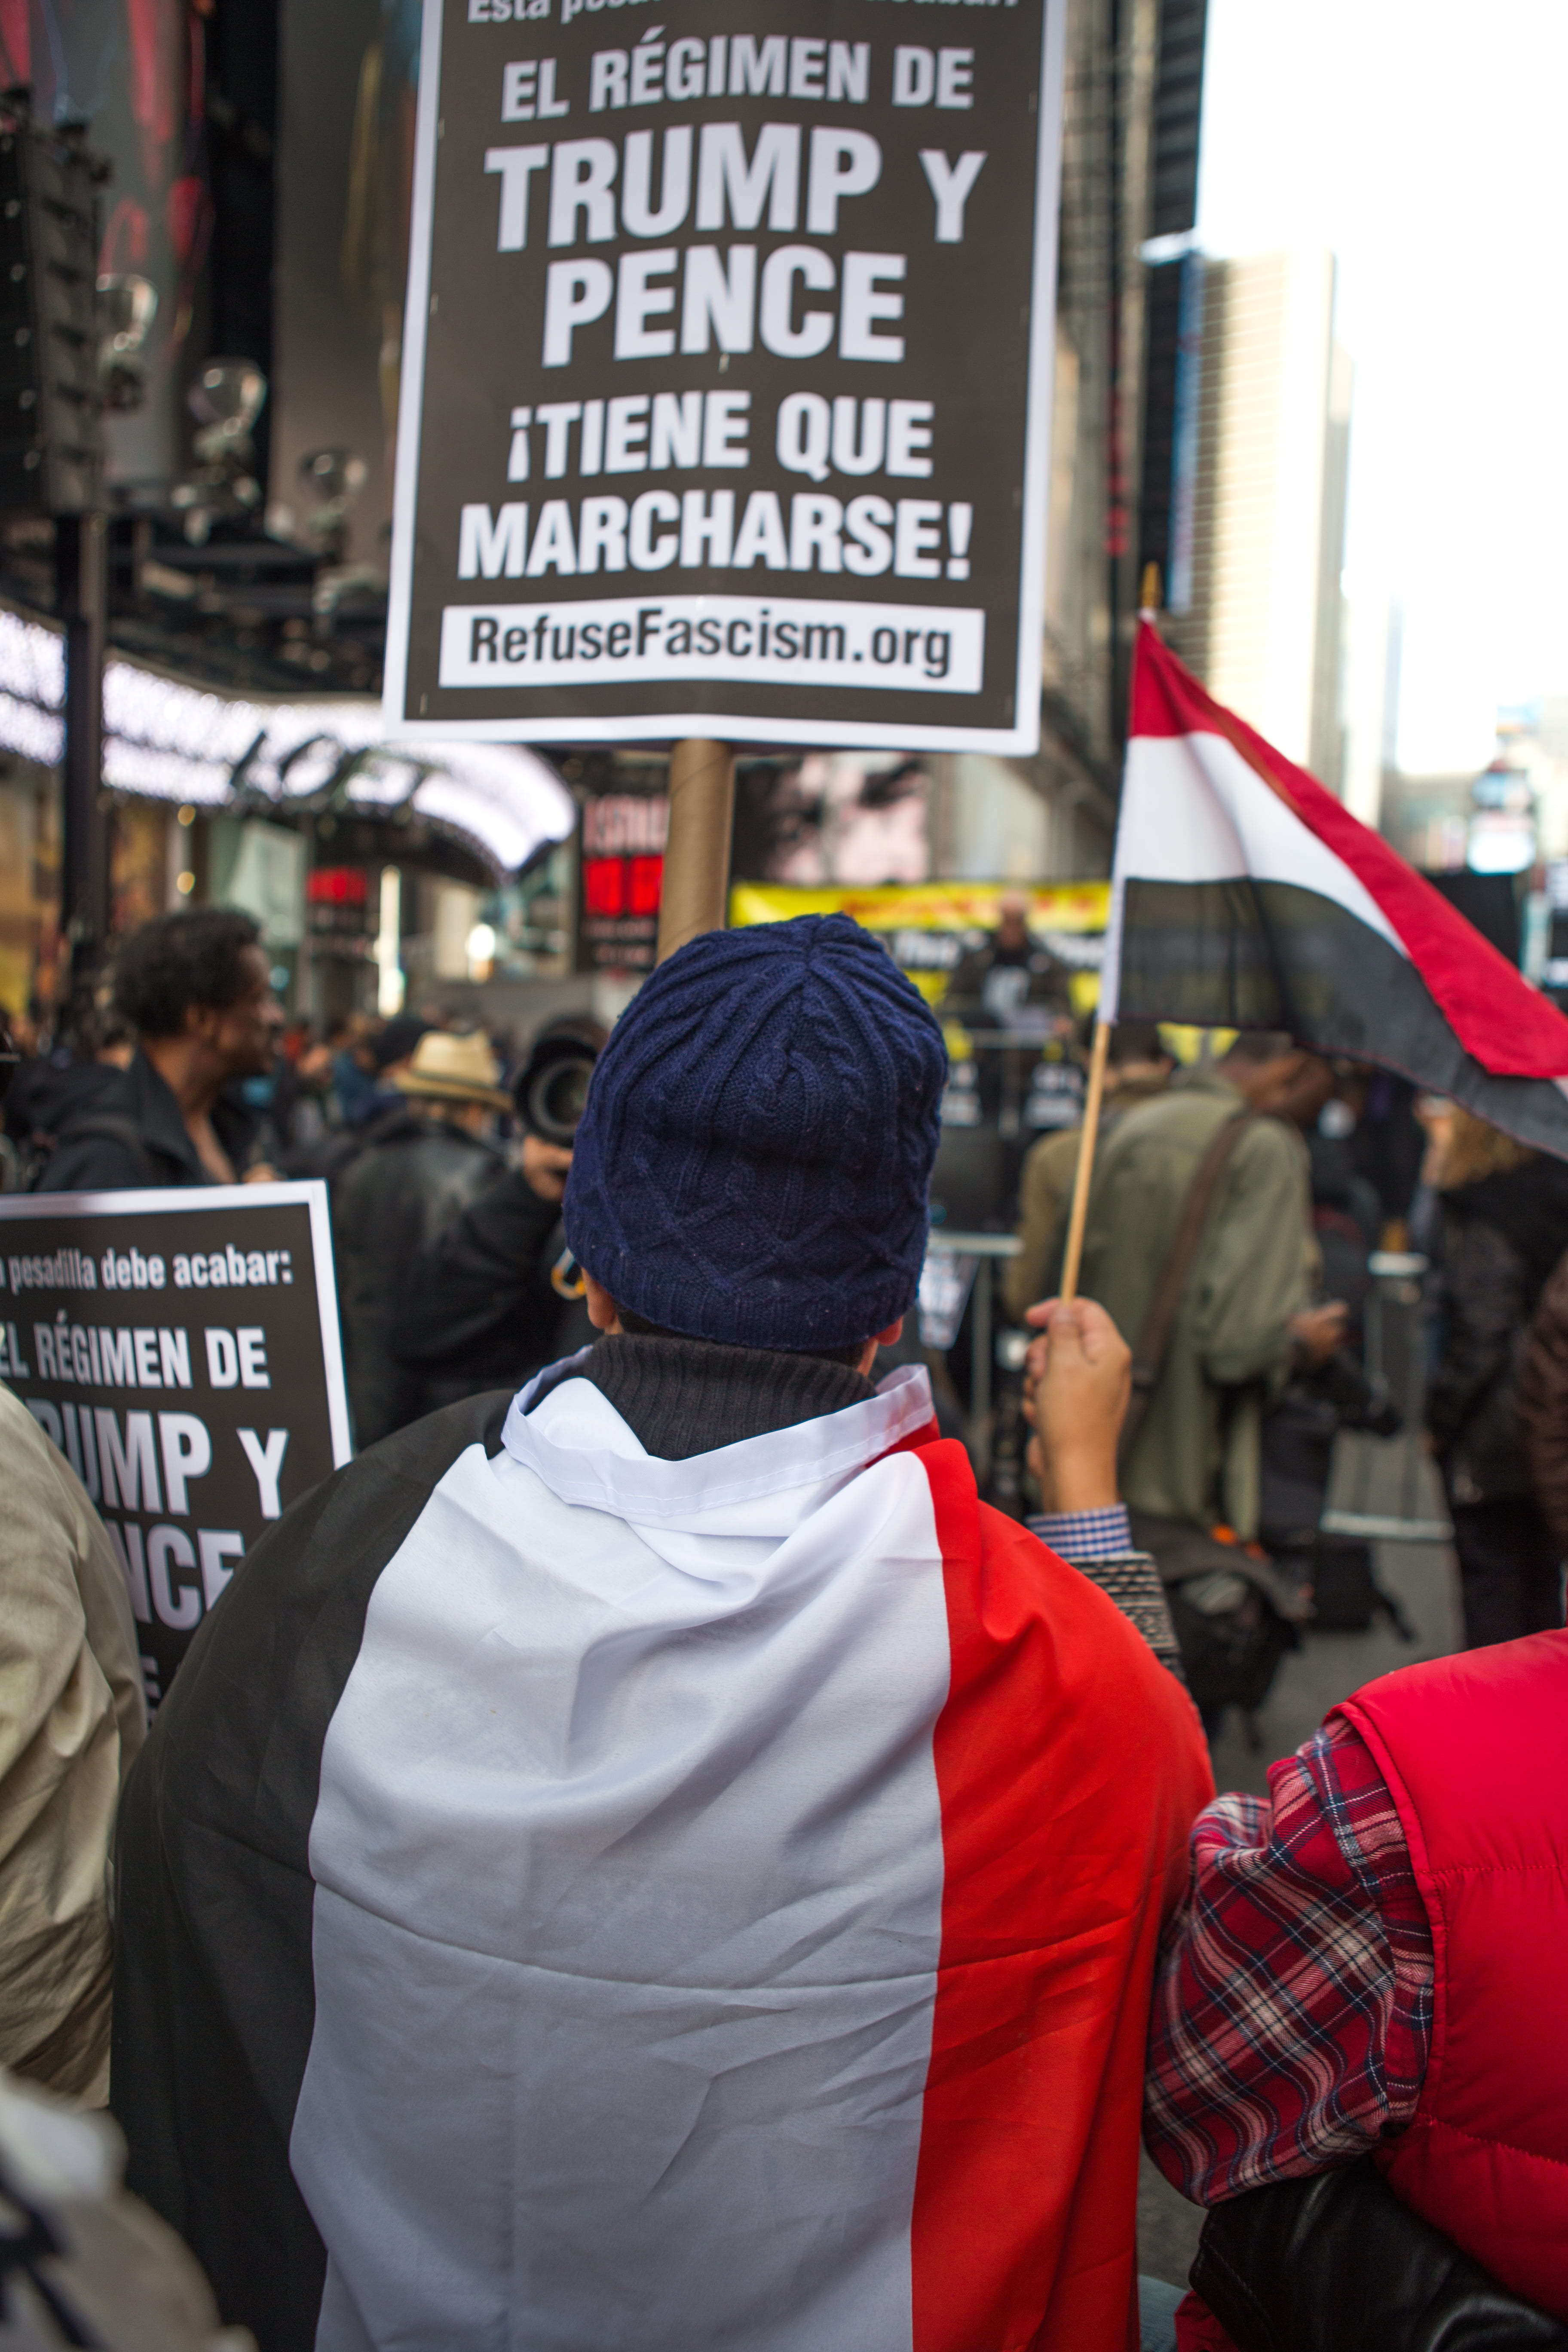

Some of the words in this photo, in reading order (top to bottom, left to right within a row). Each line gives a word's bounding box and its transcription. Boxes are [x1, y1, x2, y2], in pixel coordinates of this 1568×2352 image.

[501, 58, 570, 122] EL
[588, 25, 870, 112] RÉGIMEN
[892, 45, 974, 109] DE
[484, 122, 883, 252] TRUMP
[919, 149, 987, 243] Y
[542, 244, 906, 368] PENCE
[507, 390, 751, 482] ¡TIENE
[776, 392, 934, 482] QUE
[458, 490, 972, 580] MARCHARSE!
[470, 608, 951, 678] RefuseFascism.org
[8, 1247, 98, 1295] pesadilla
[101, 1246, 166, 1289] debe
[173, 1243, 293, 1288] acabar:
[34, 1309, 193, 1388] RÉGIMEN
[204, 1327, 271, 1389] DE
[236, 1428, 289, 1519] Y
